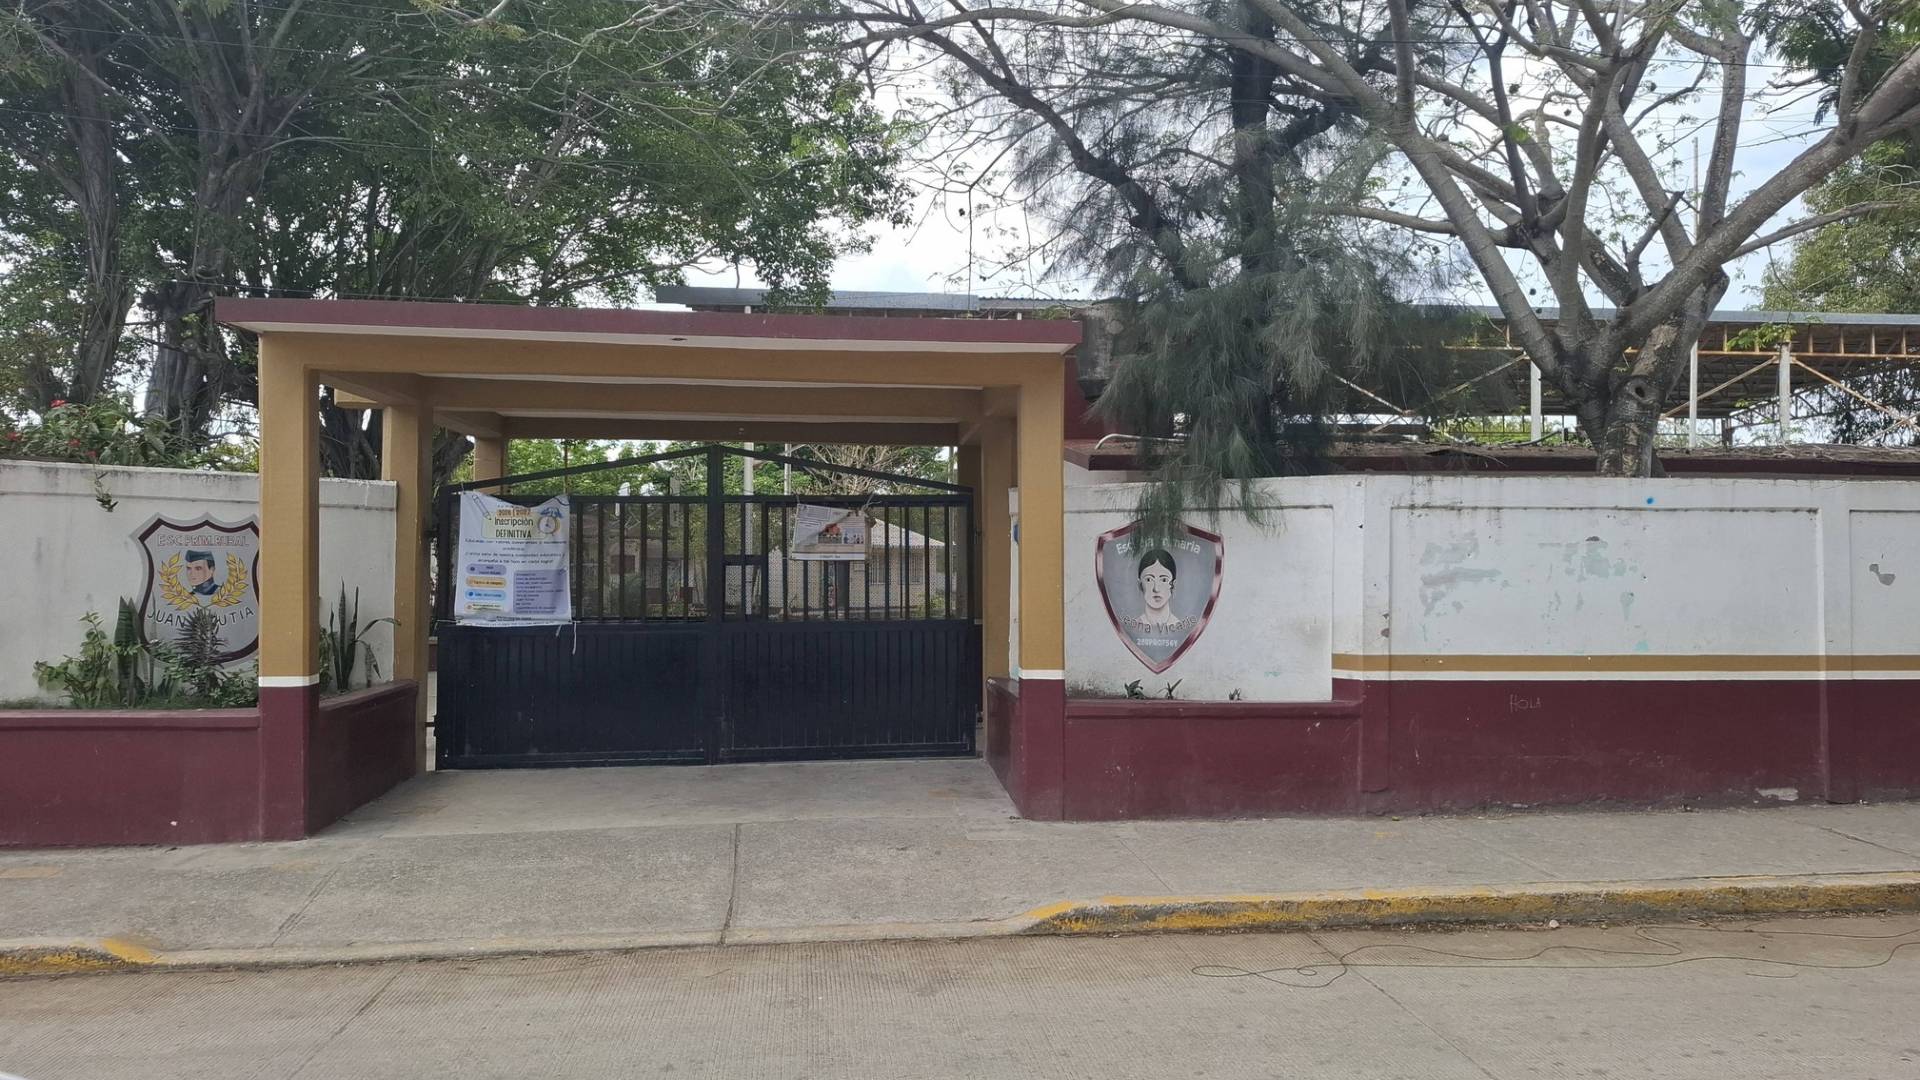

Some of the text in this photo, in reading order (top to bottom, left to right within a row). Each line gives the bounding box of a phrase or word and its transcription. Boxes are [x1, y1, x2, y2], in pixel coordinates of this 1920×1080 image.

[494, 516, 534, 527] Inscripción
[495, 529, 532, 538] DEFINITIVA
[147, 607, 187, 629] JUAN
